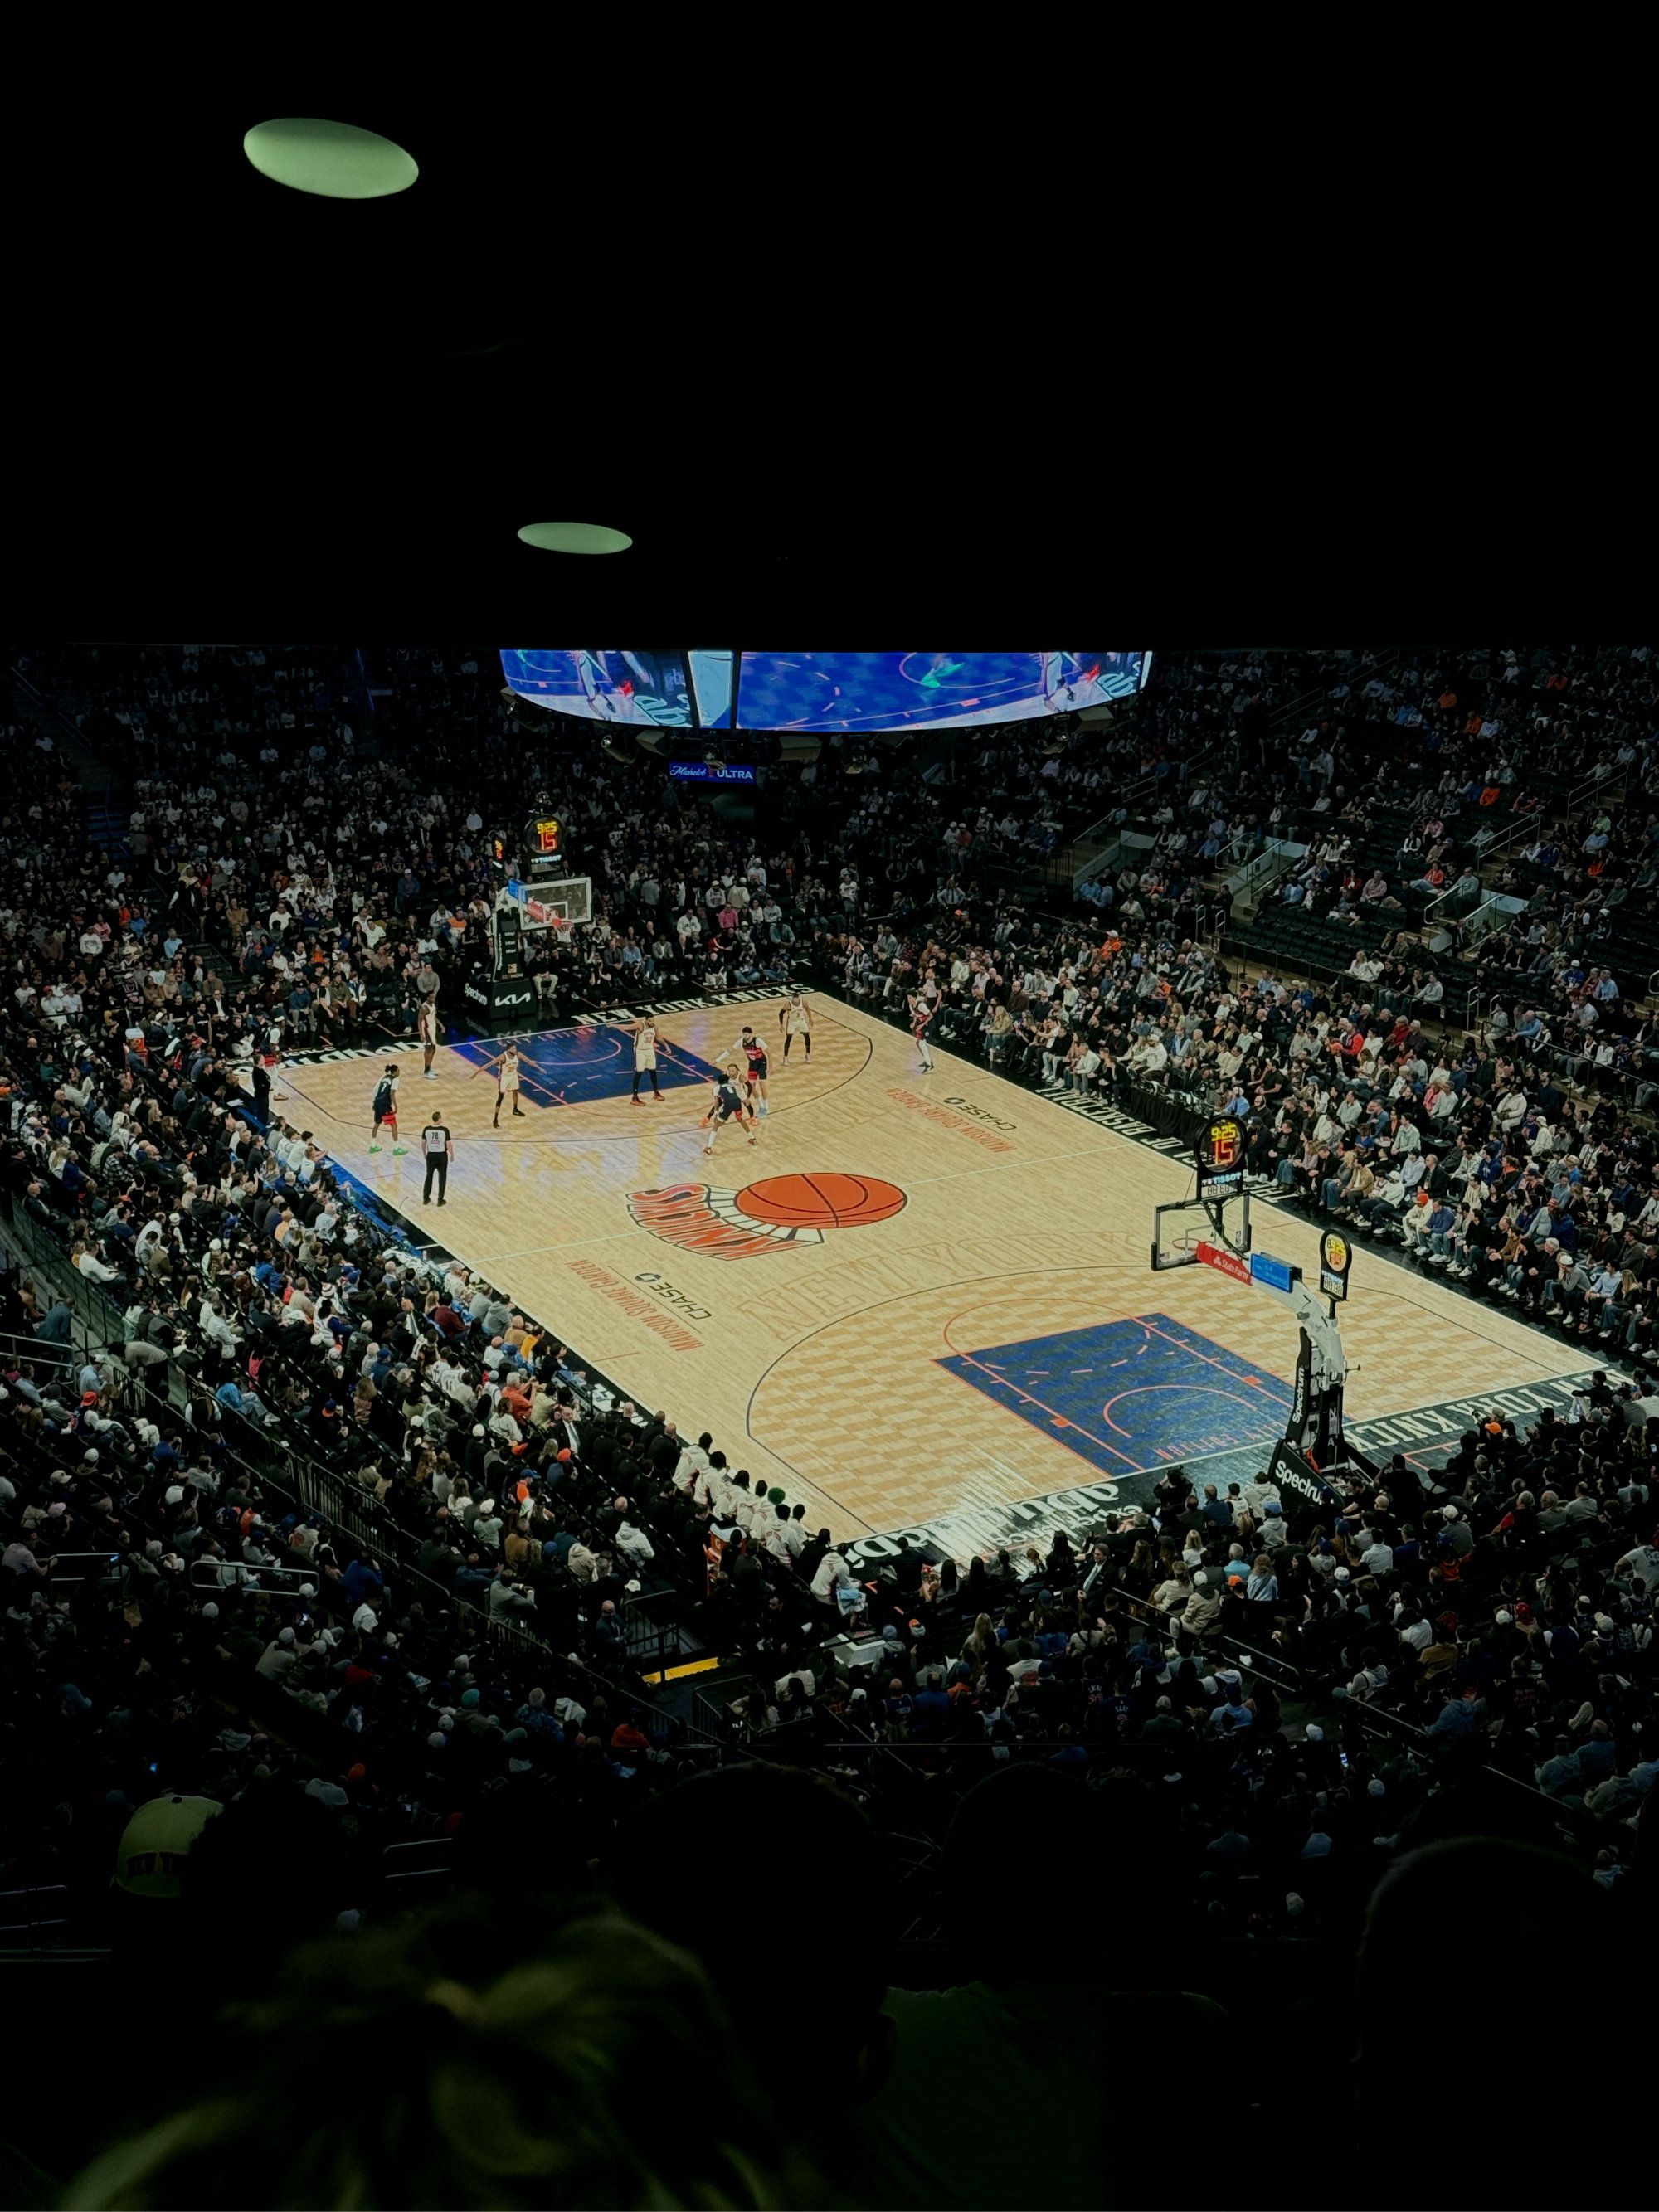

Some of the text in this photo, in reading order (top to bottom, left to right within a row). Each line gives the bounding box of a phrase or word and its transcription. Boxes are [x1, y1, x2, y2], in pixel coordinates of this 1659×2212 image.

[669, 765, 753, 780] Michelob ULTRA
[539, 832, 557, 851] 15
[571, 983, 816, 1026] NEW YORK KNICKS
[957, 1103, 1018, 1131] CHASE
[1211, 1121, 1238, 1142] 9:25
[956, 1125, 1018, 1153] MADISON
[1139, 1136, 1185, 1150] OF
[1214, 1139, 1234, 1164] 15
[1213, 1172, 1243, 1184] TISSOT
[625, 1183, 825, 1262] KNICKS
[564, 1258, 706, 1352] MADISON SQUARE GARDEN
[648, 1281, 713, 1320] CHASE
[739, 1252, 915, 1341] NEW
[1292, 1366, 1306, 1424] Spectrum
[1341, 1409, 1464, 1453] KNICK
[1274, 1460, 1324, 1505] Spectru
[1006, 1483, 1120, 1522] abu
